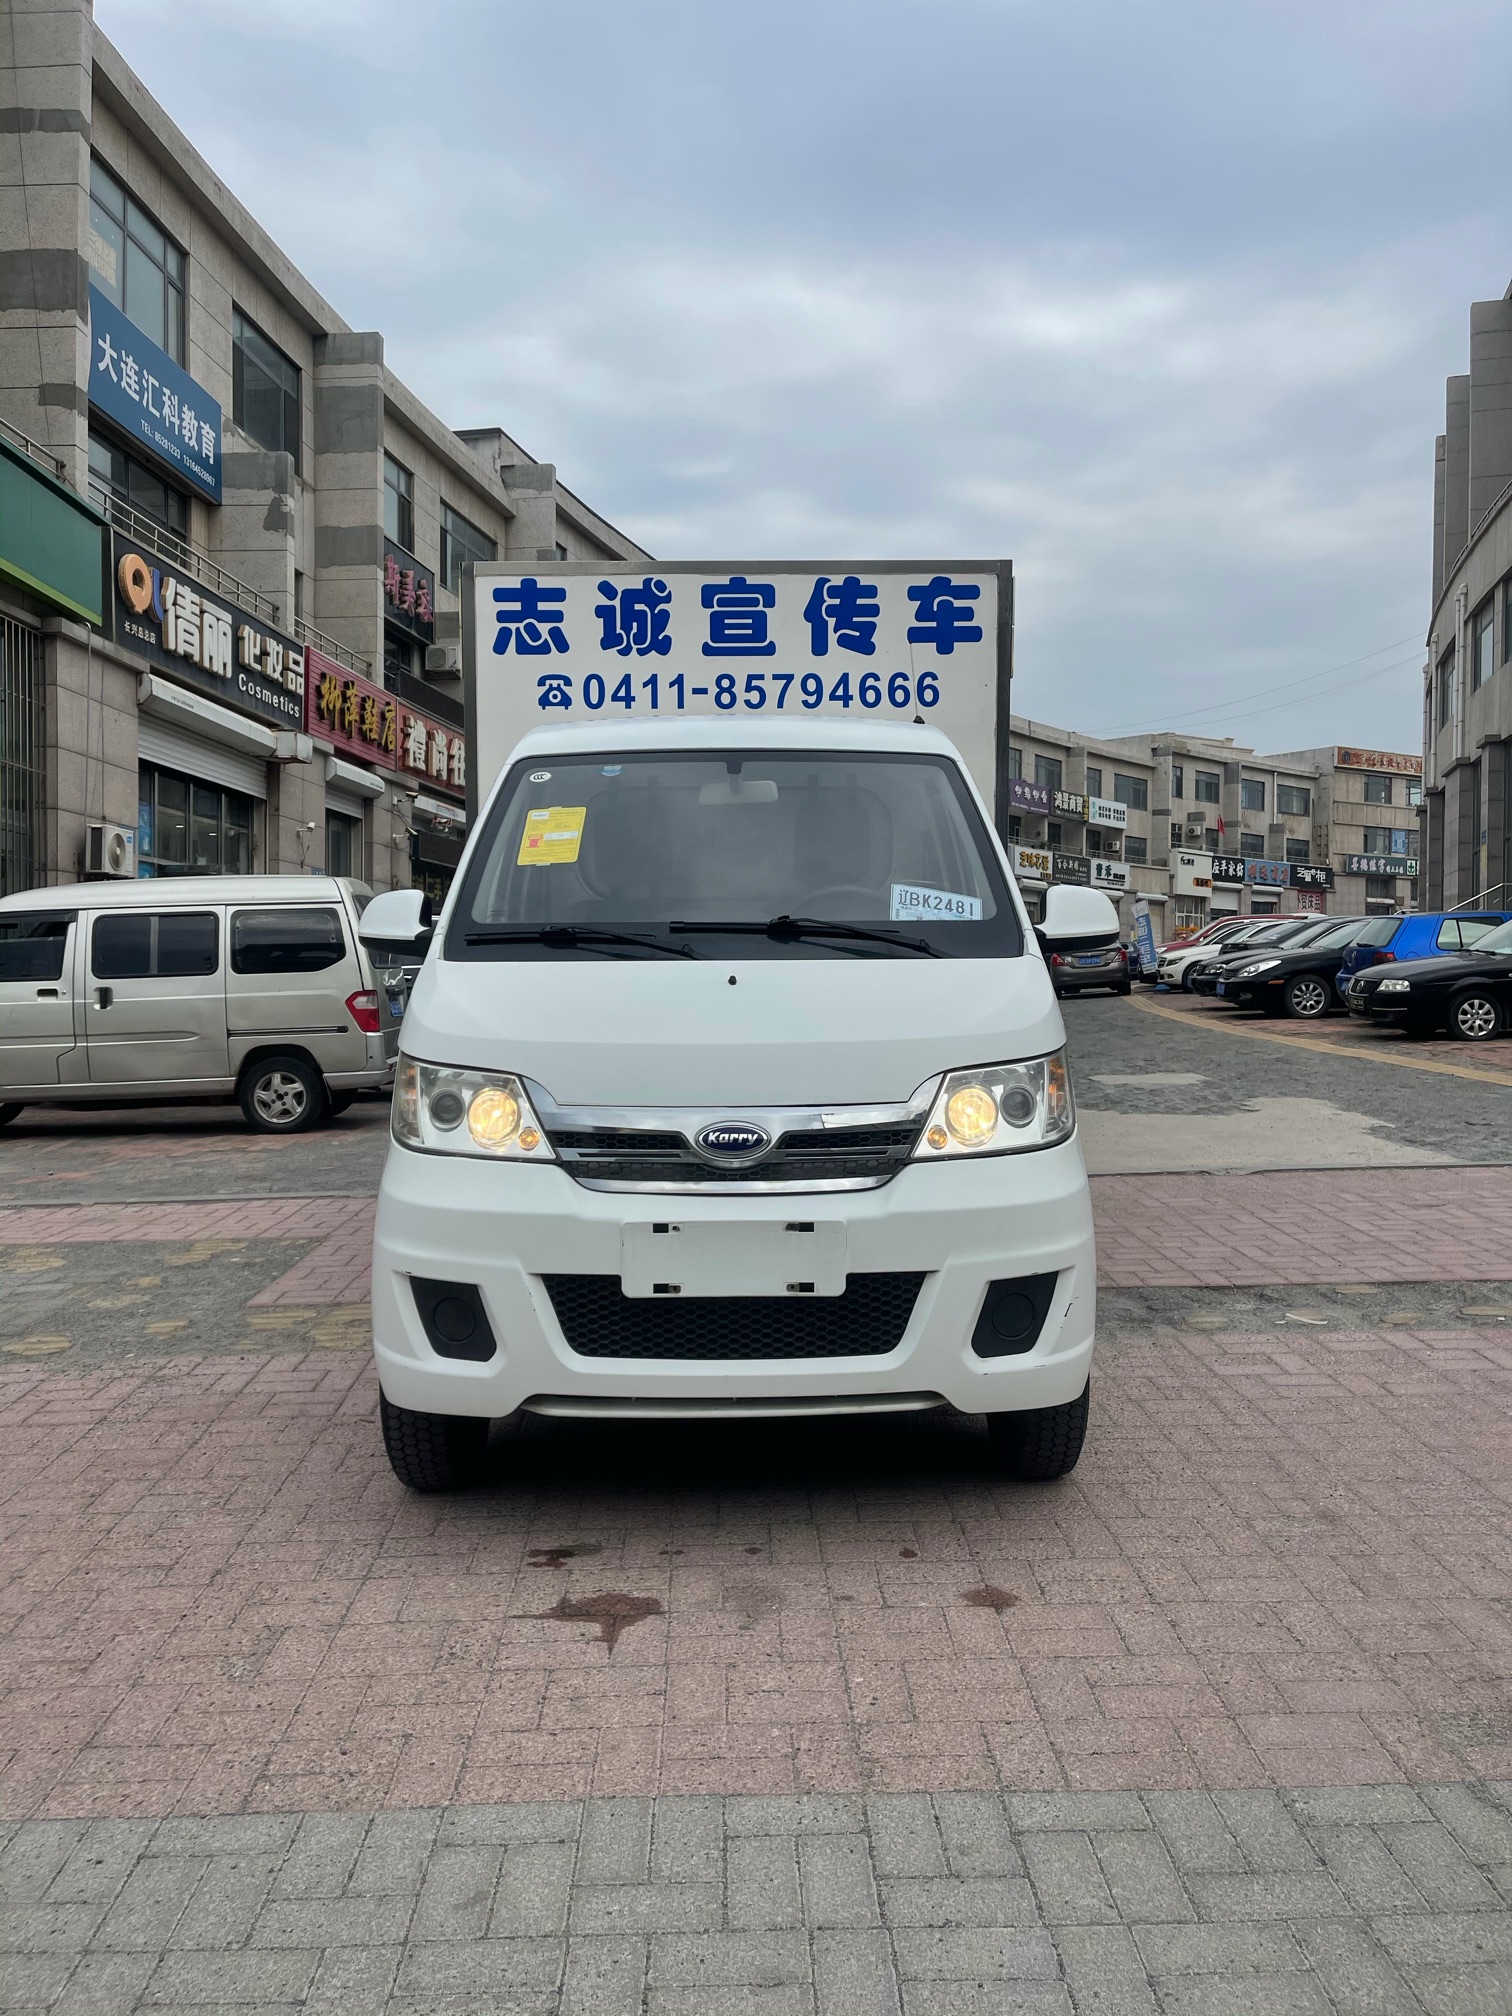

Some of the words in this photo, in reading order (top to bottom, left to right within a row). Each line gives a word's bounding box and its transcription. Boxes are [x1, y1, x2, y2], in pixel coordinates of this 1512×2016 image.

[98, 333, 217, 465] 大连汇科教育
[124, 620, 156, 645] 长兴岛总店
[492, 576, 983, 657] 志诚宣传车
[238, 624, 303, 697] 化妆品
[238, 673, 300, 718] Cosmetics
[582, 672, 941, 710] 0411-85794666
[898, 889, 974, 917] 辽BK2481
[707, 1131, 759, 1146] Karry
